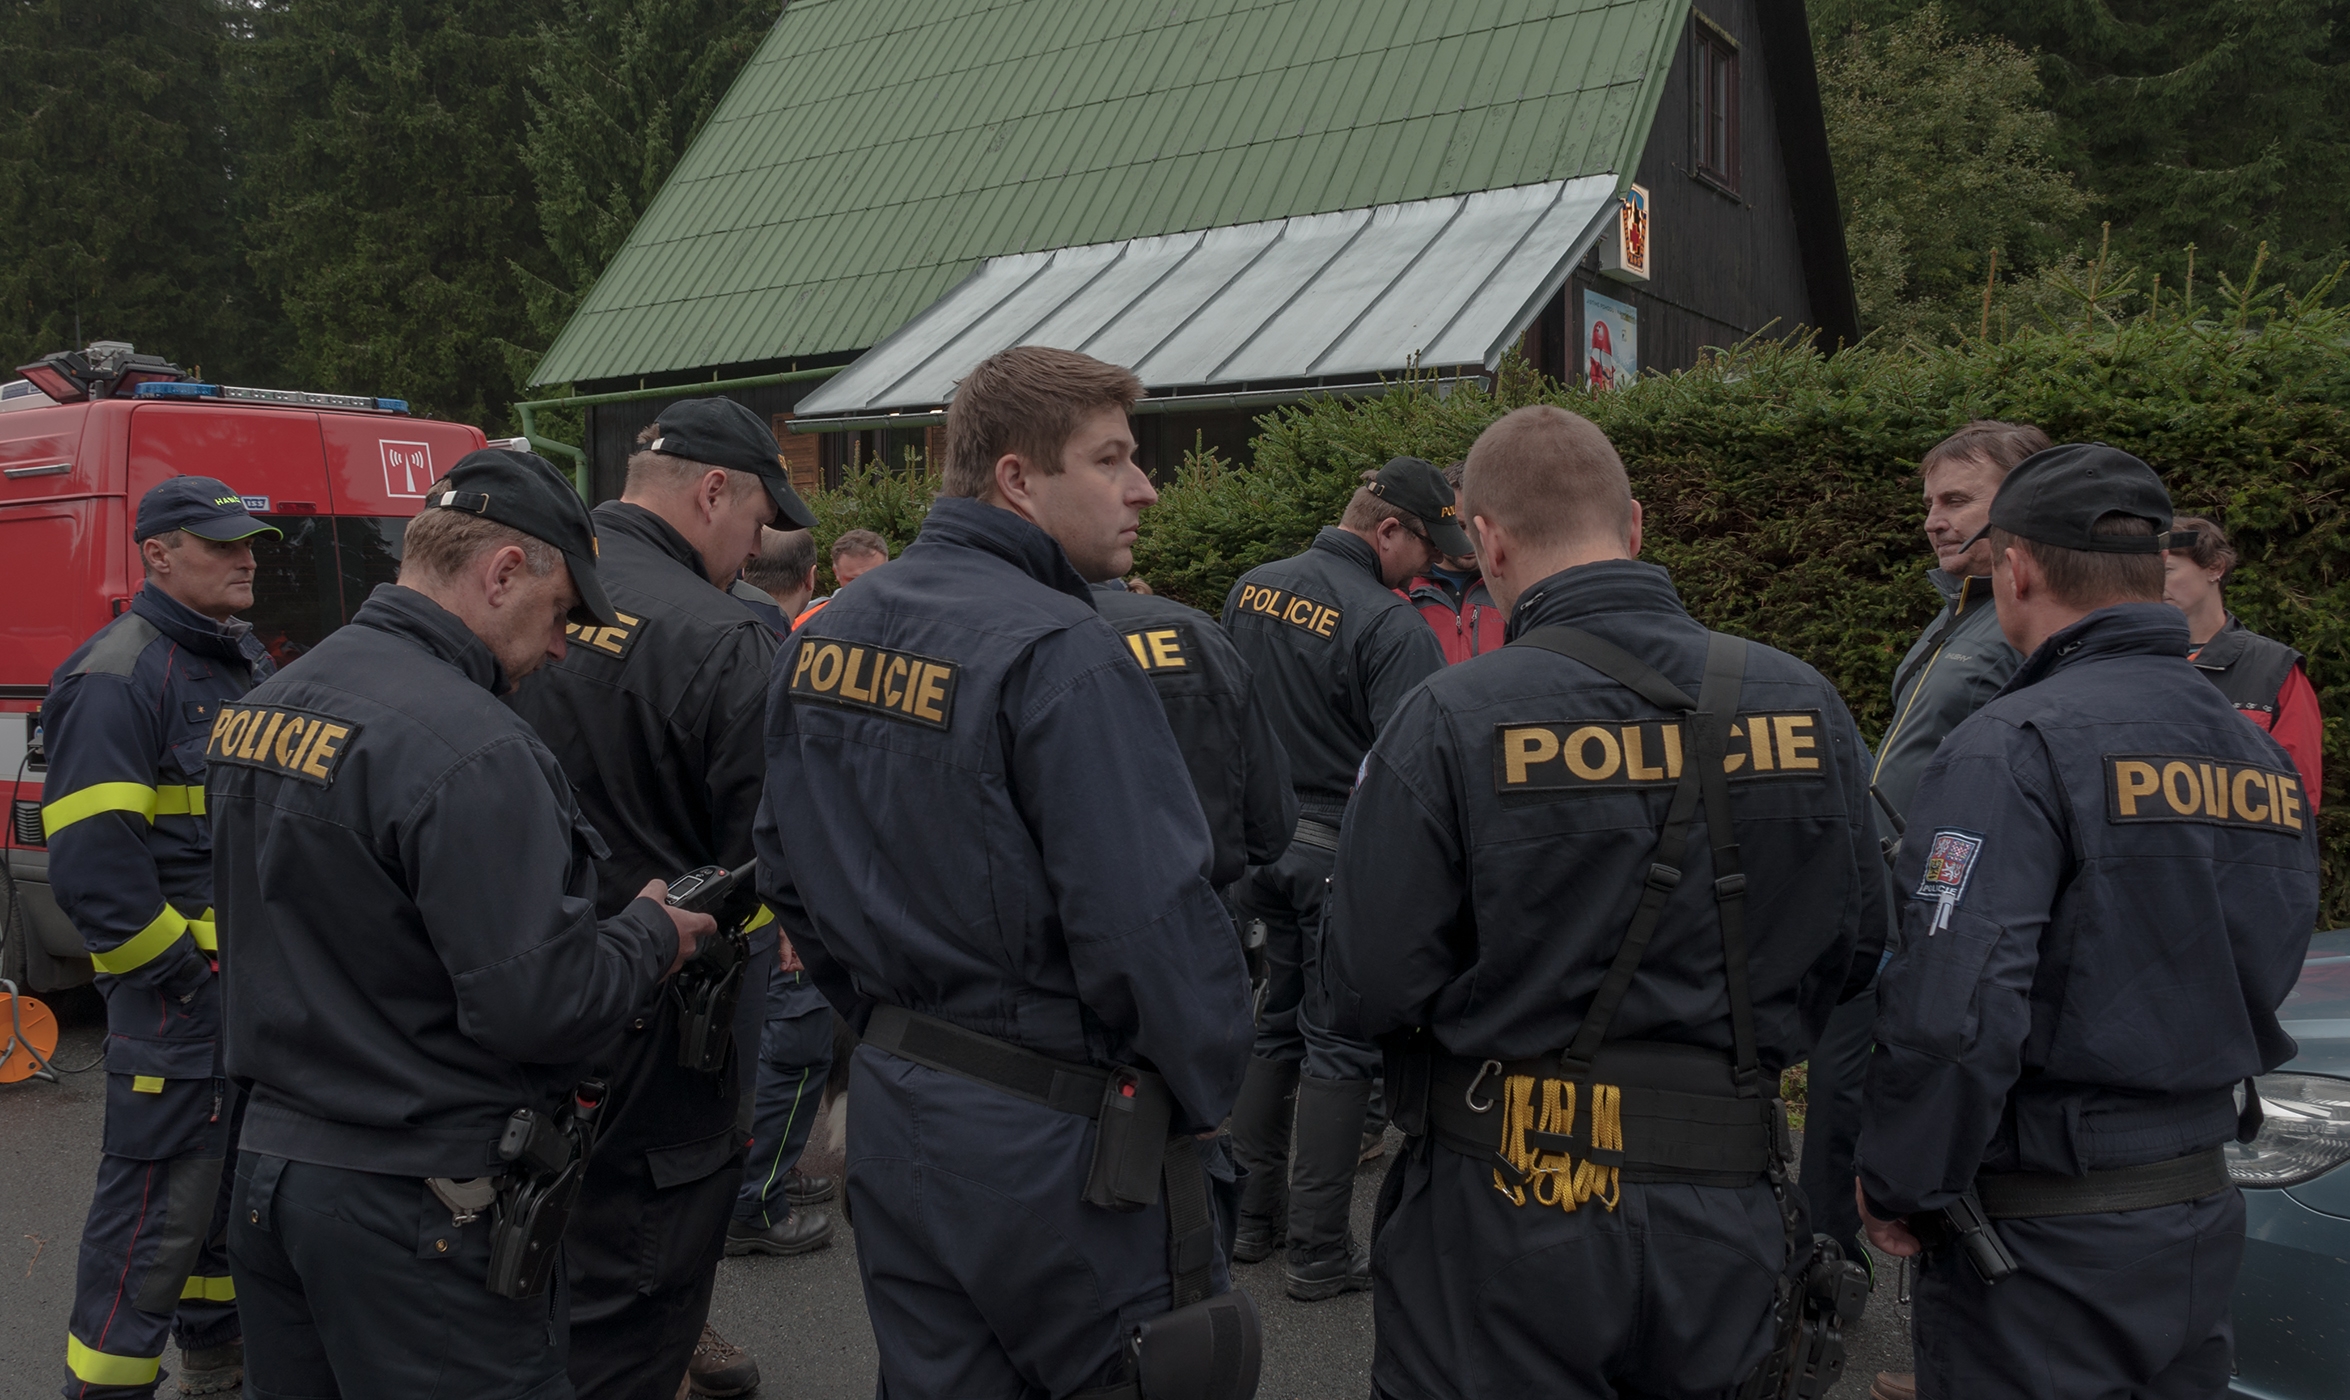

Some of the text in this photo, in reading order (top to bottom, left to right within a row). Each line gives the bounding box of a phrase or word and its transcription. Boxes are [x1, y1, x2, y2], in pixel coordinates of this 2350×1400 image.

[1239, 585, 1340, 637] POLICIE
[791, 642, 951, 722] POLICIE
[206, 708, 349, 780] POLICIE
